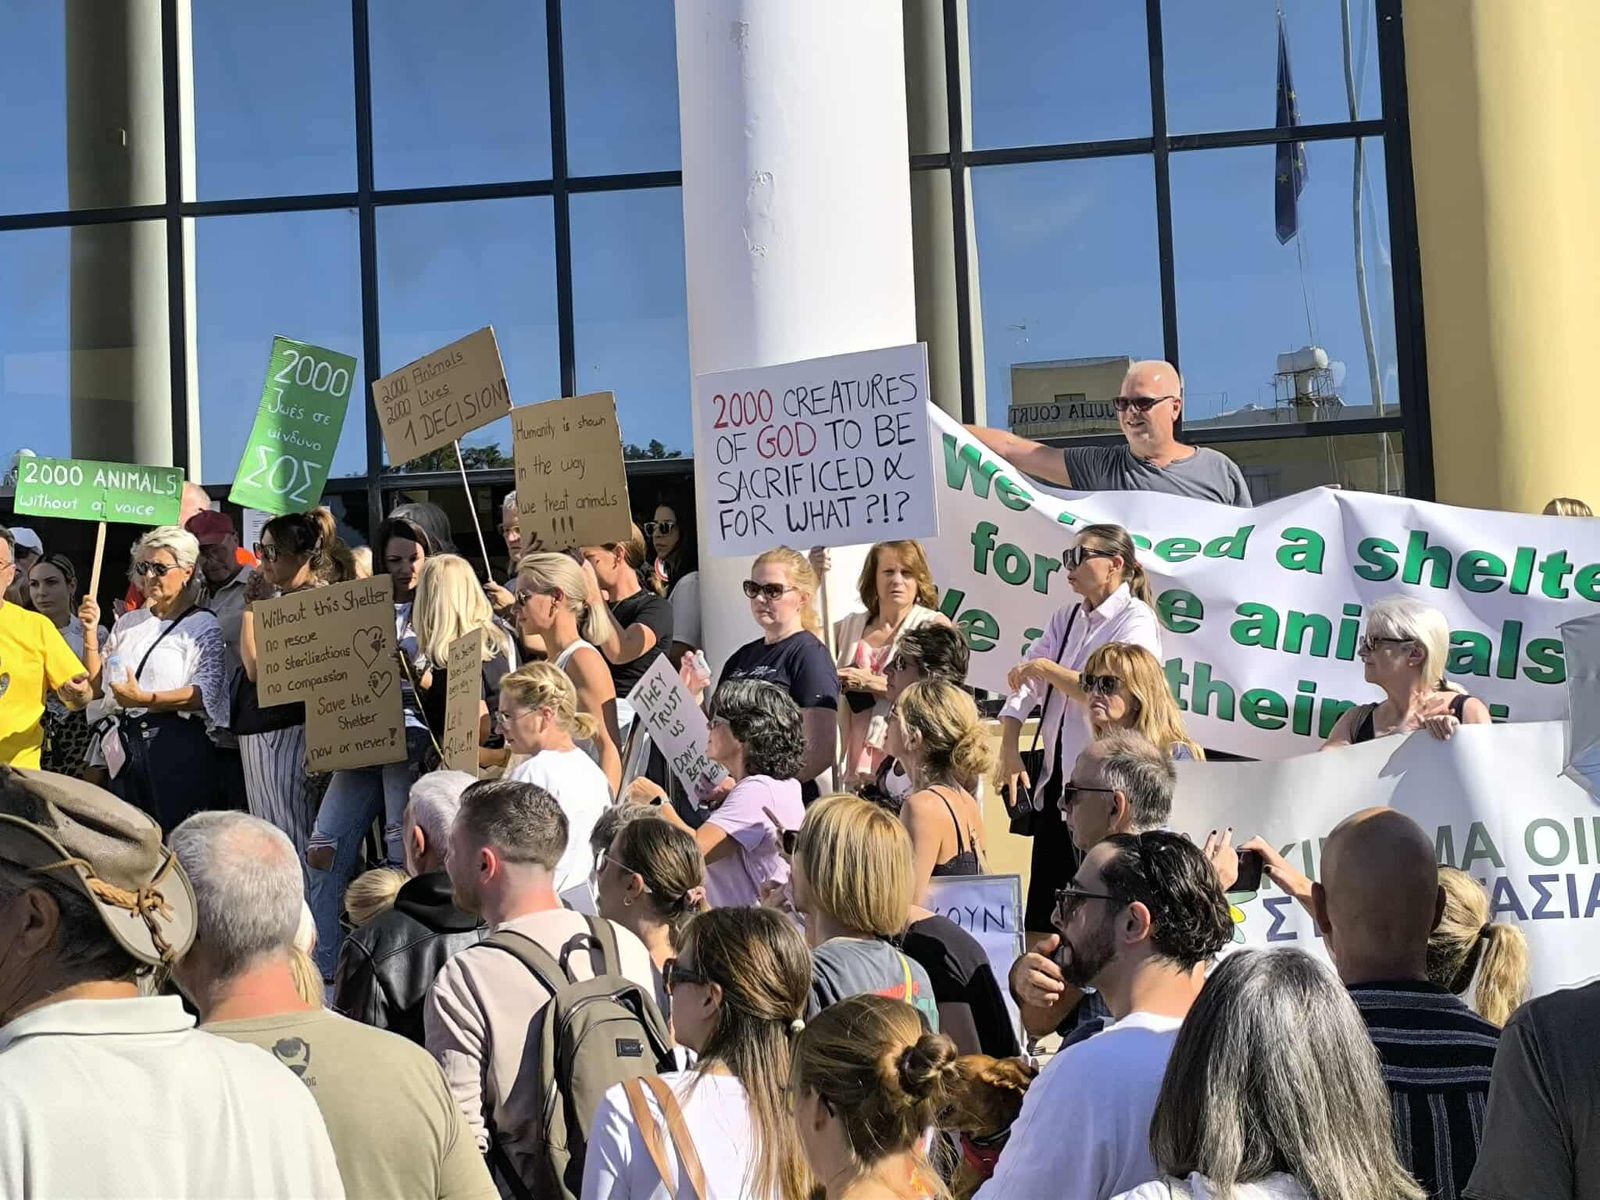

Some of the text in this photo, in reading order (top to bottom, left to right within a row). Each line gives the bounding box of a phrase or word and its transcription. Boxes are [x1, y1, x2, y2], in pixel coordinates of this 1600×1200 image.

[274, 350, 349, 397] 2000
[382, 352, 464, 403] 2000 Animals
[387, 384, 450, 424] 2000 Lives
[713, 373, 918, 429] 2000 CREATURES
[405, 420, 416, 446] 1
[516, 415, 606, 440] Humanity is shown
[716, 412, 915, 465] OF GOD TO BE
[24, 462, 178, 496] 2000 ANIMALS
[243, 445, 322, 503] ΣΟΣ
[518, 455, 586, 481] in the way
[717, 456, 874, 504] SACRIFICED
[19, 493, 77, 511] without
[115, 502, 155, 516] voice
[521, 488, 617, 515] we treat animals
[719, 504, 774, 540] FOR
[786, 496, 856, 532] WHAT
[942, 432, 1034, 512] We
[1276, 527, 1325, 575] a
[262, 587, 388, 629] Without this Shelter
[970, 521, 1062, 595] for
[1230, 602, 1567, 685] anials
[266, 631, 318, 653] no rescue
[266, 664, 279, 674] no
[267, 669, 347, 695] no compassion
[317, 693, 371, 716] Save the
[633, 672, 667, 711] THEY
[649, 686, 682, 730] TRUST
[338, 712, 378, 731] Shelter
[670, 720, 685, 737] US
[310, 743, 332, 761] now
[339, 741, 350, 754] or
[673, 740, 697, 774] DON'T
[685, 755, 711, 782] BETR
